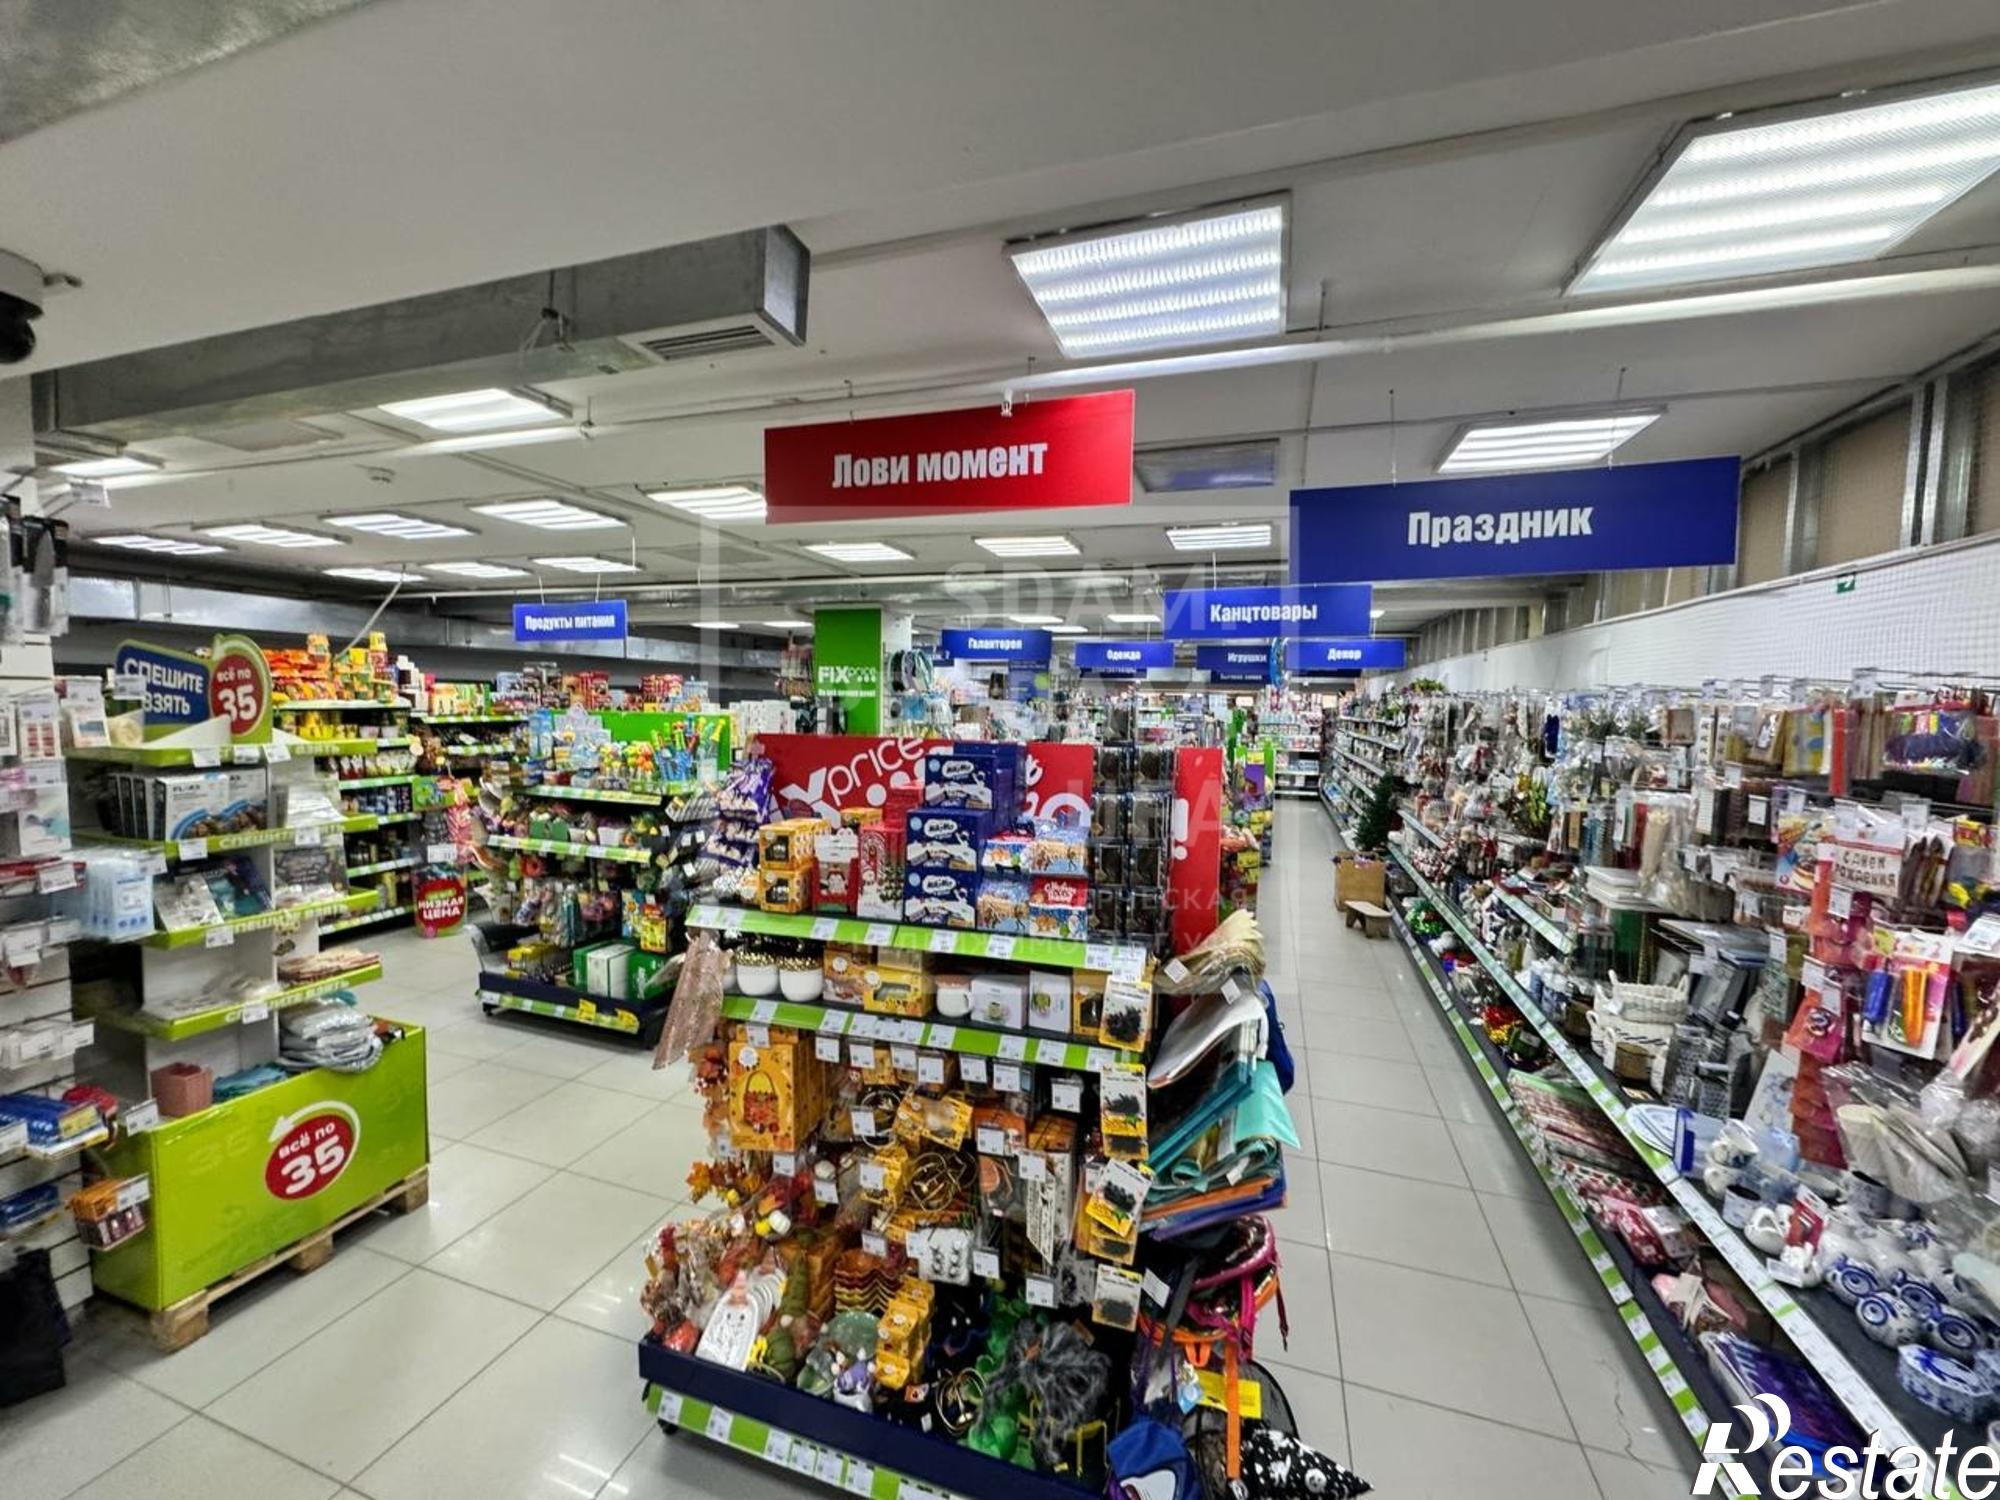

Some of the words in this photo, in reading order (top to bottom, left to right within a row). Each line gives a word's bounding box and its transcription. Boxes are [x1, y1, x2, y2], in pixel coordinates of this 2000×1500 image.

[832, 454, 909, 489] Лови
[917, 443, 1048, 483] момент
[1407, 506, 1594, 548] Праздник
[525, 615, 573, 632] Продукты
[574, 614, 615, 628] питания
[1210, 603, 1318, 624] Канцтовары
[968, 637, 1022, 650] Галантерея
[1106, 649, 1141, 661] Одежда
[1227, 652, 1267, 663] Игрушки
[1327, 648, 1362, 661] Декор
[123, 658, 205, 694] СПЕШИТЕ
[237, 667, 252, 680] по
[818, 665, 850, 684] FIX
[142, 691, 191, 716] ВЗЯТЬ
[218, 684, 257, 722] 35
[418, 896, 465, 909] НИЗКАЯ
[423, 906, 461, 920] ЦЕНА
[314, 1121, 336, 1141] по
[281, 1134, 345, 1195] 35
